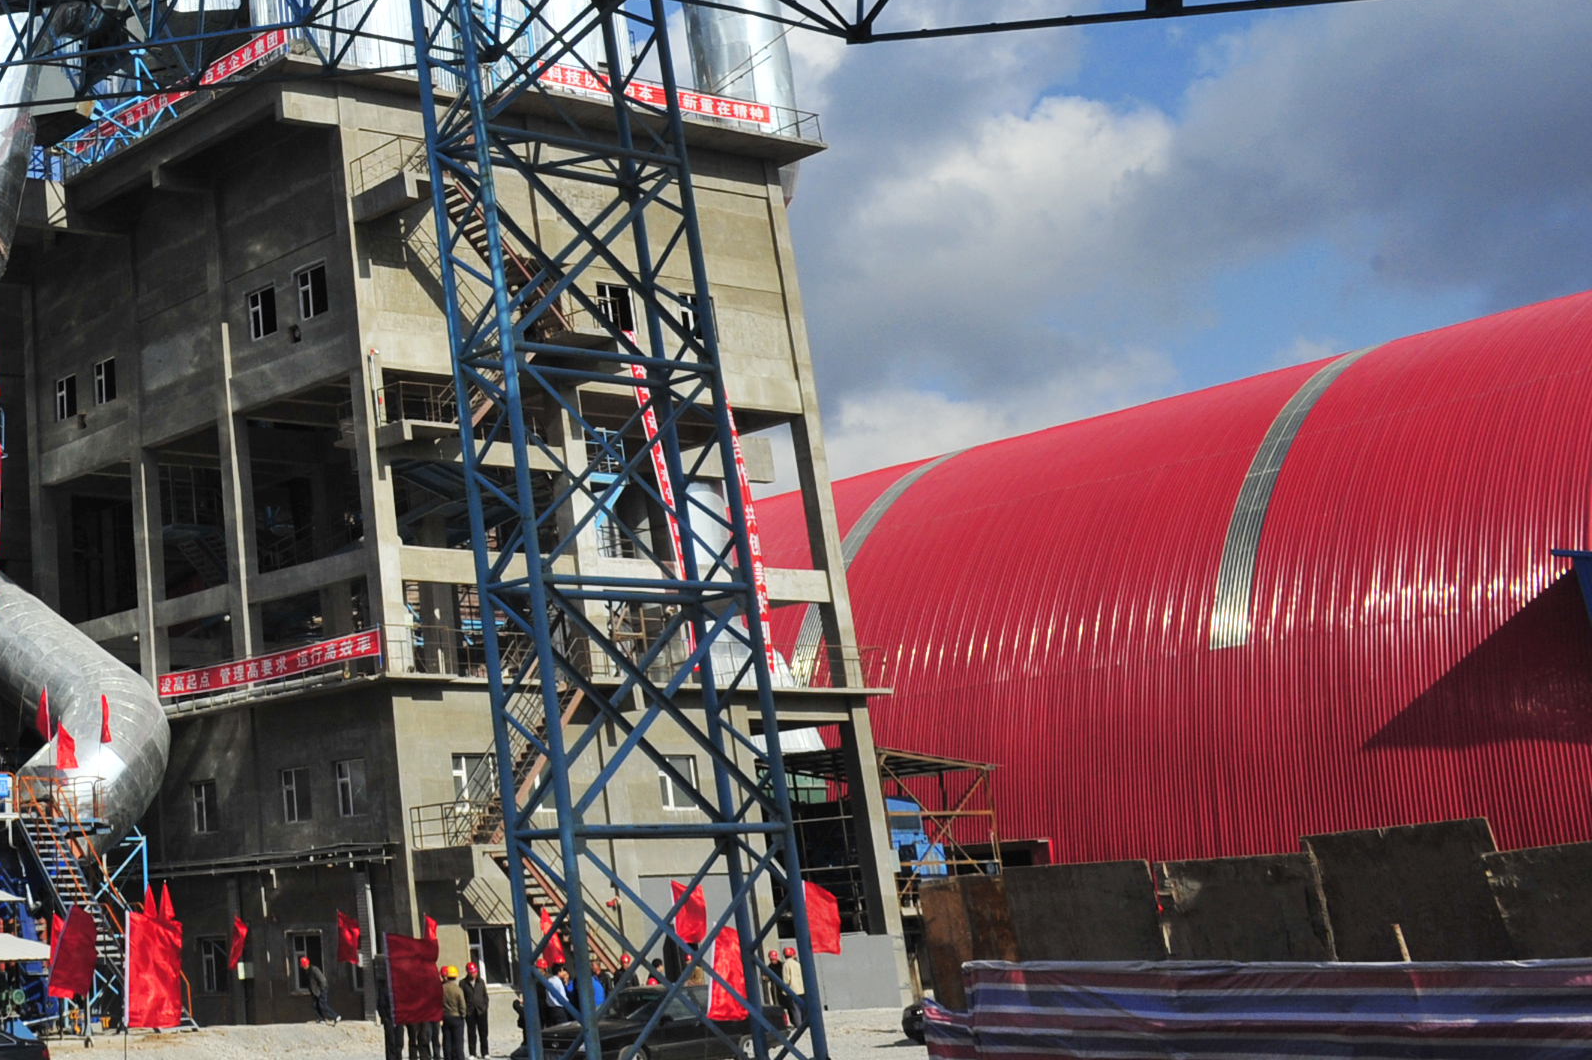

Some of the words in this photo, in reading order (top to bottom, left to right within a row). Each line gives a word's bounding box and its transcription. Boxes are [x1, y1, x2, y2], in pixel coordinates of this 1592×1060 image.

[547, 66, 653, 100] 科技以为本
[677, 92, 764, 121] 新重在精神
[219, 655, 288, 684] 管理高要求
[296, 635, 372, 668] 运行高效率
